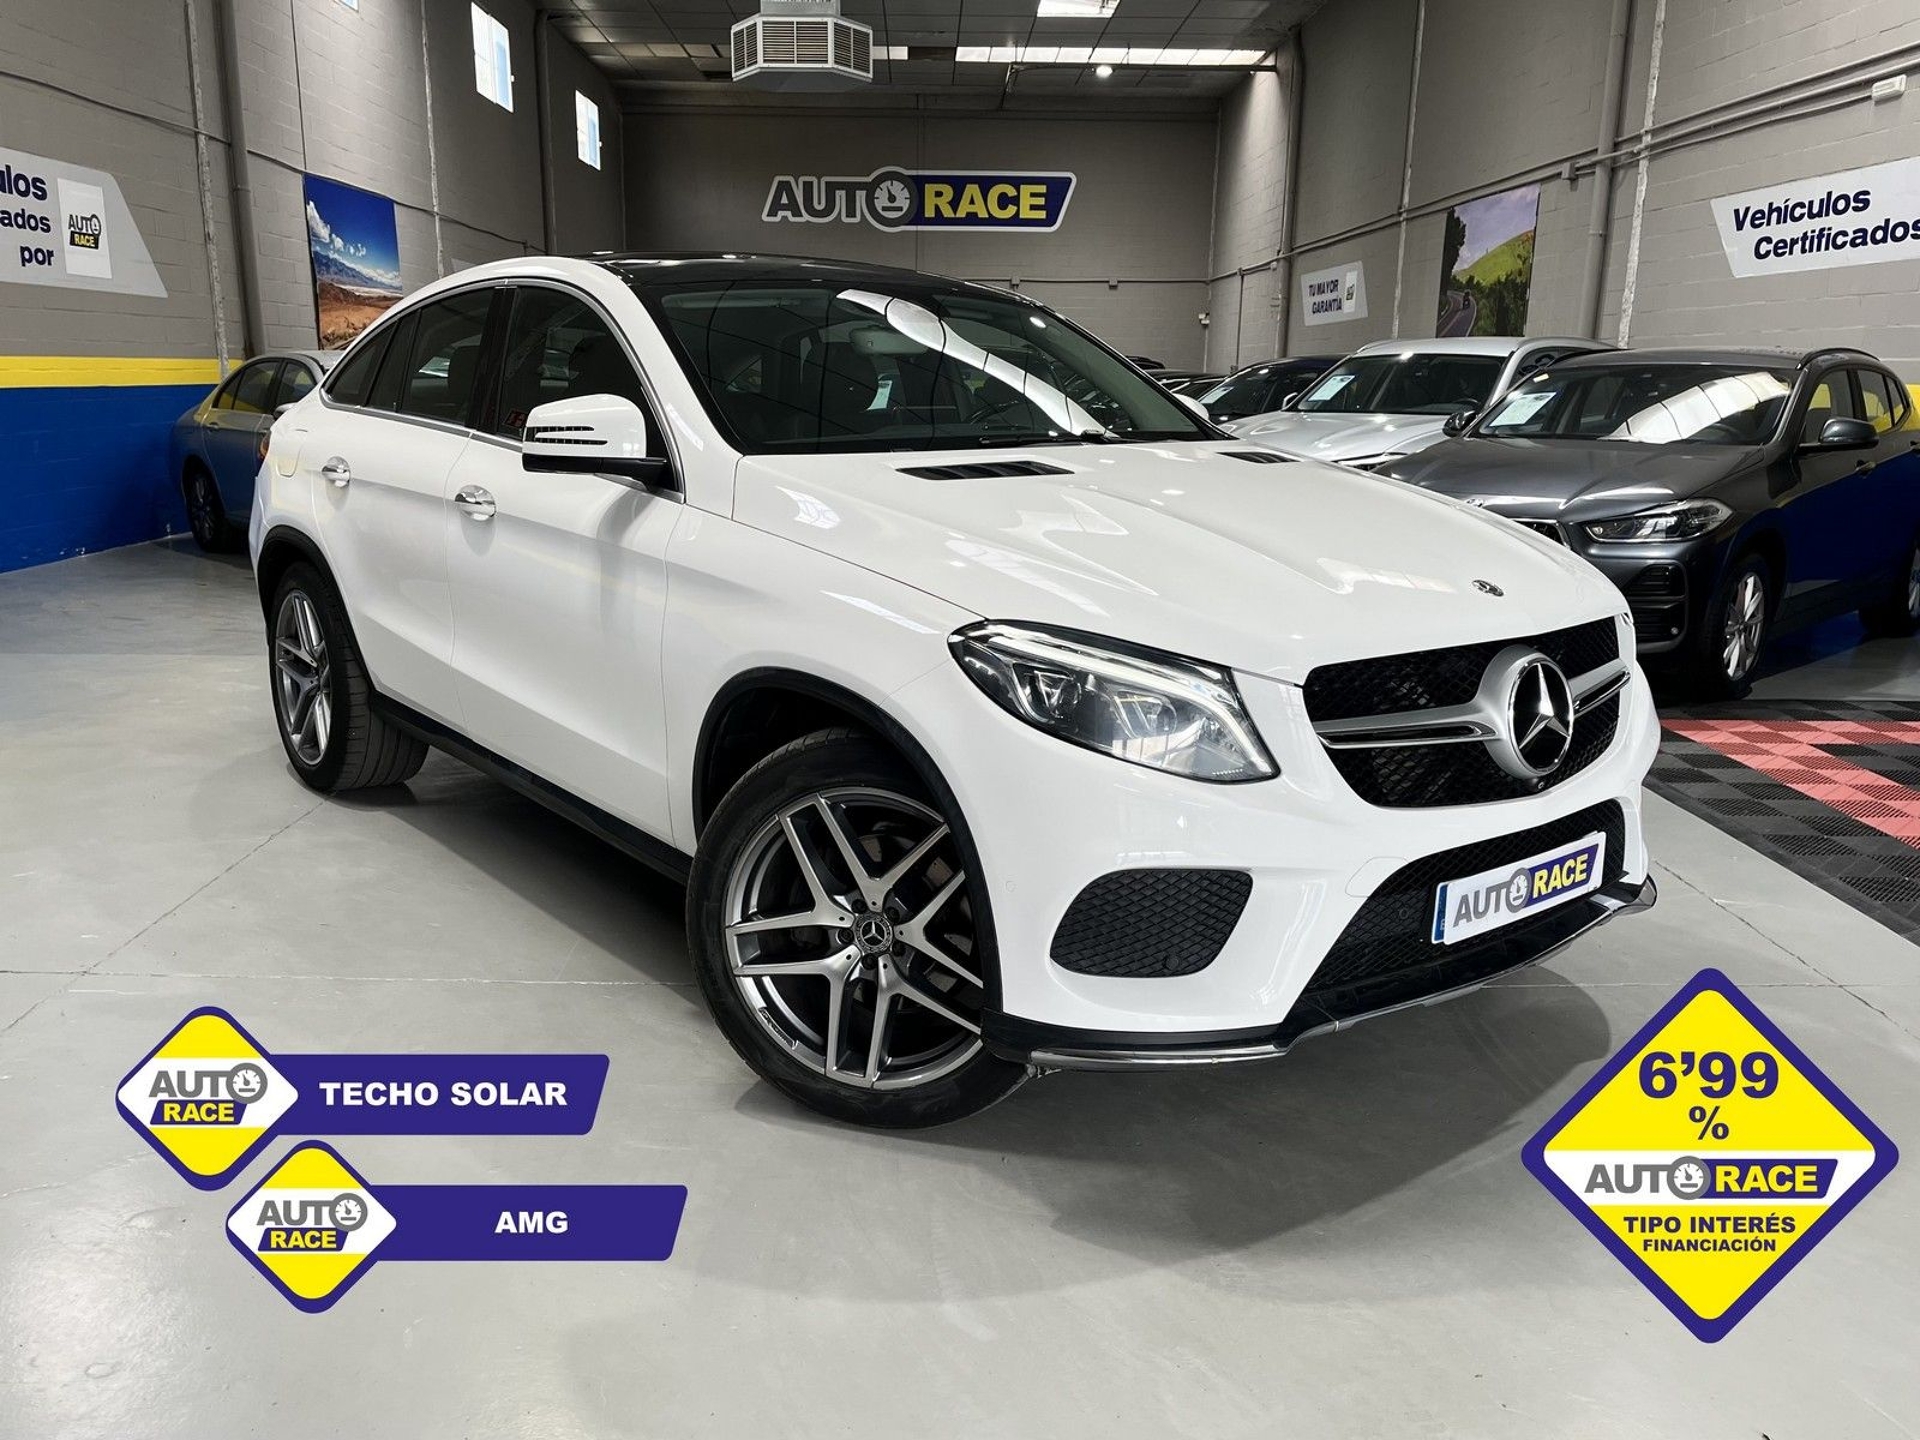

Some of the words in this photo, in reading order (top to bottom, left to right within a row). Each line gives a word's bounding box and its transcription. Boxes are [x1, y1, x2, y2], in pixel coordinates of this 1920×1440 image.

[765, 170, 919, 229] AUTO
[924, 183, 1047, 219] RACE
[1733, 190, 1871, 231] Vehículos
[68, 213, 102, 236] AUTO
[73, 233, 96, 247] RACE
[20, 245, 54, 267] por
[1316, 279, 1339, 295] MAYOR
[1452, 867, 1532, 928] AUTO
[1532, 853, 1589, 899] RACE
